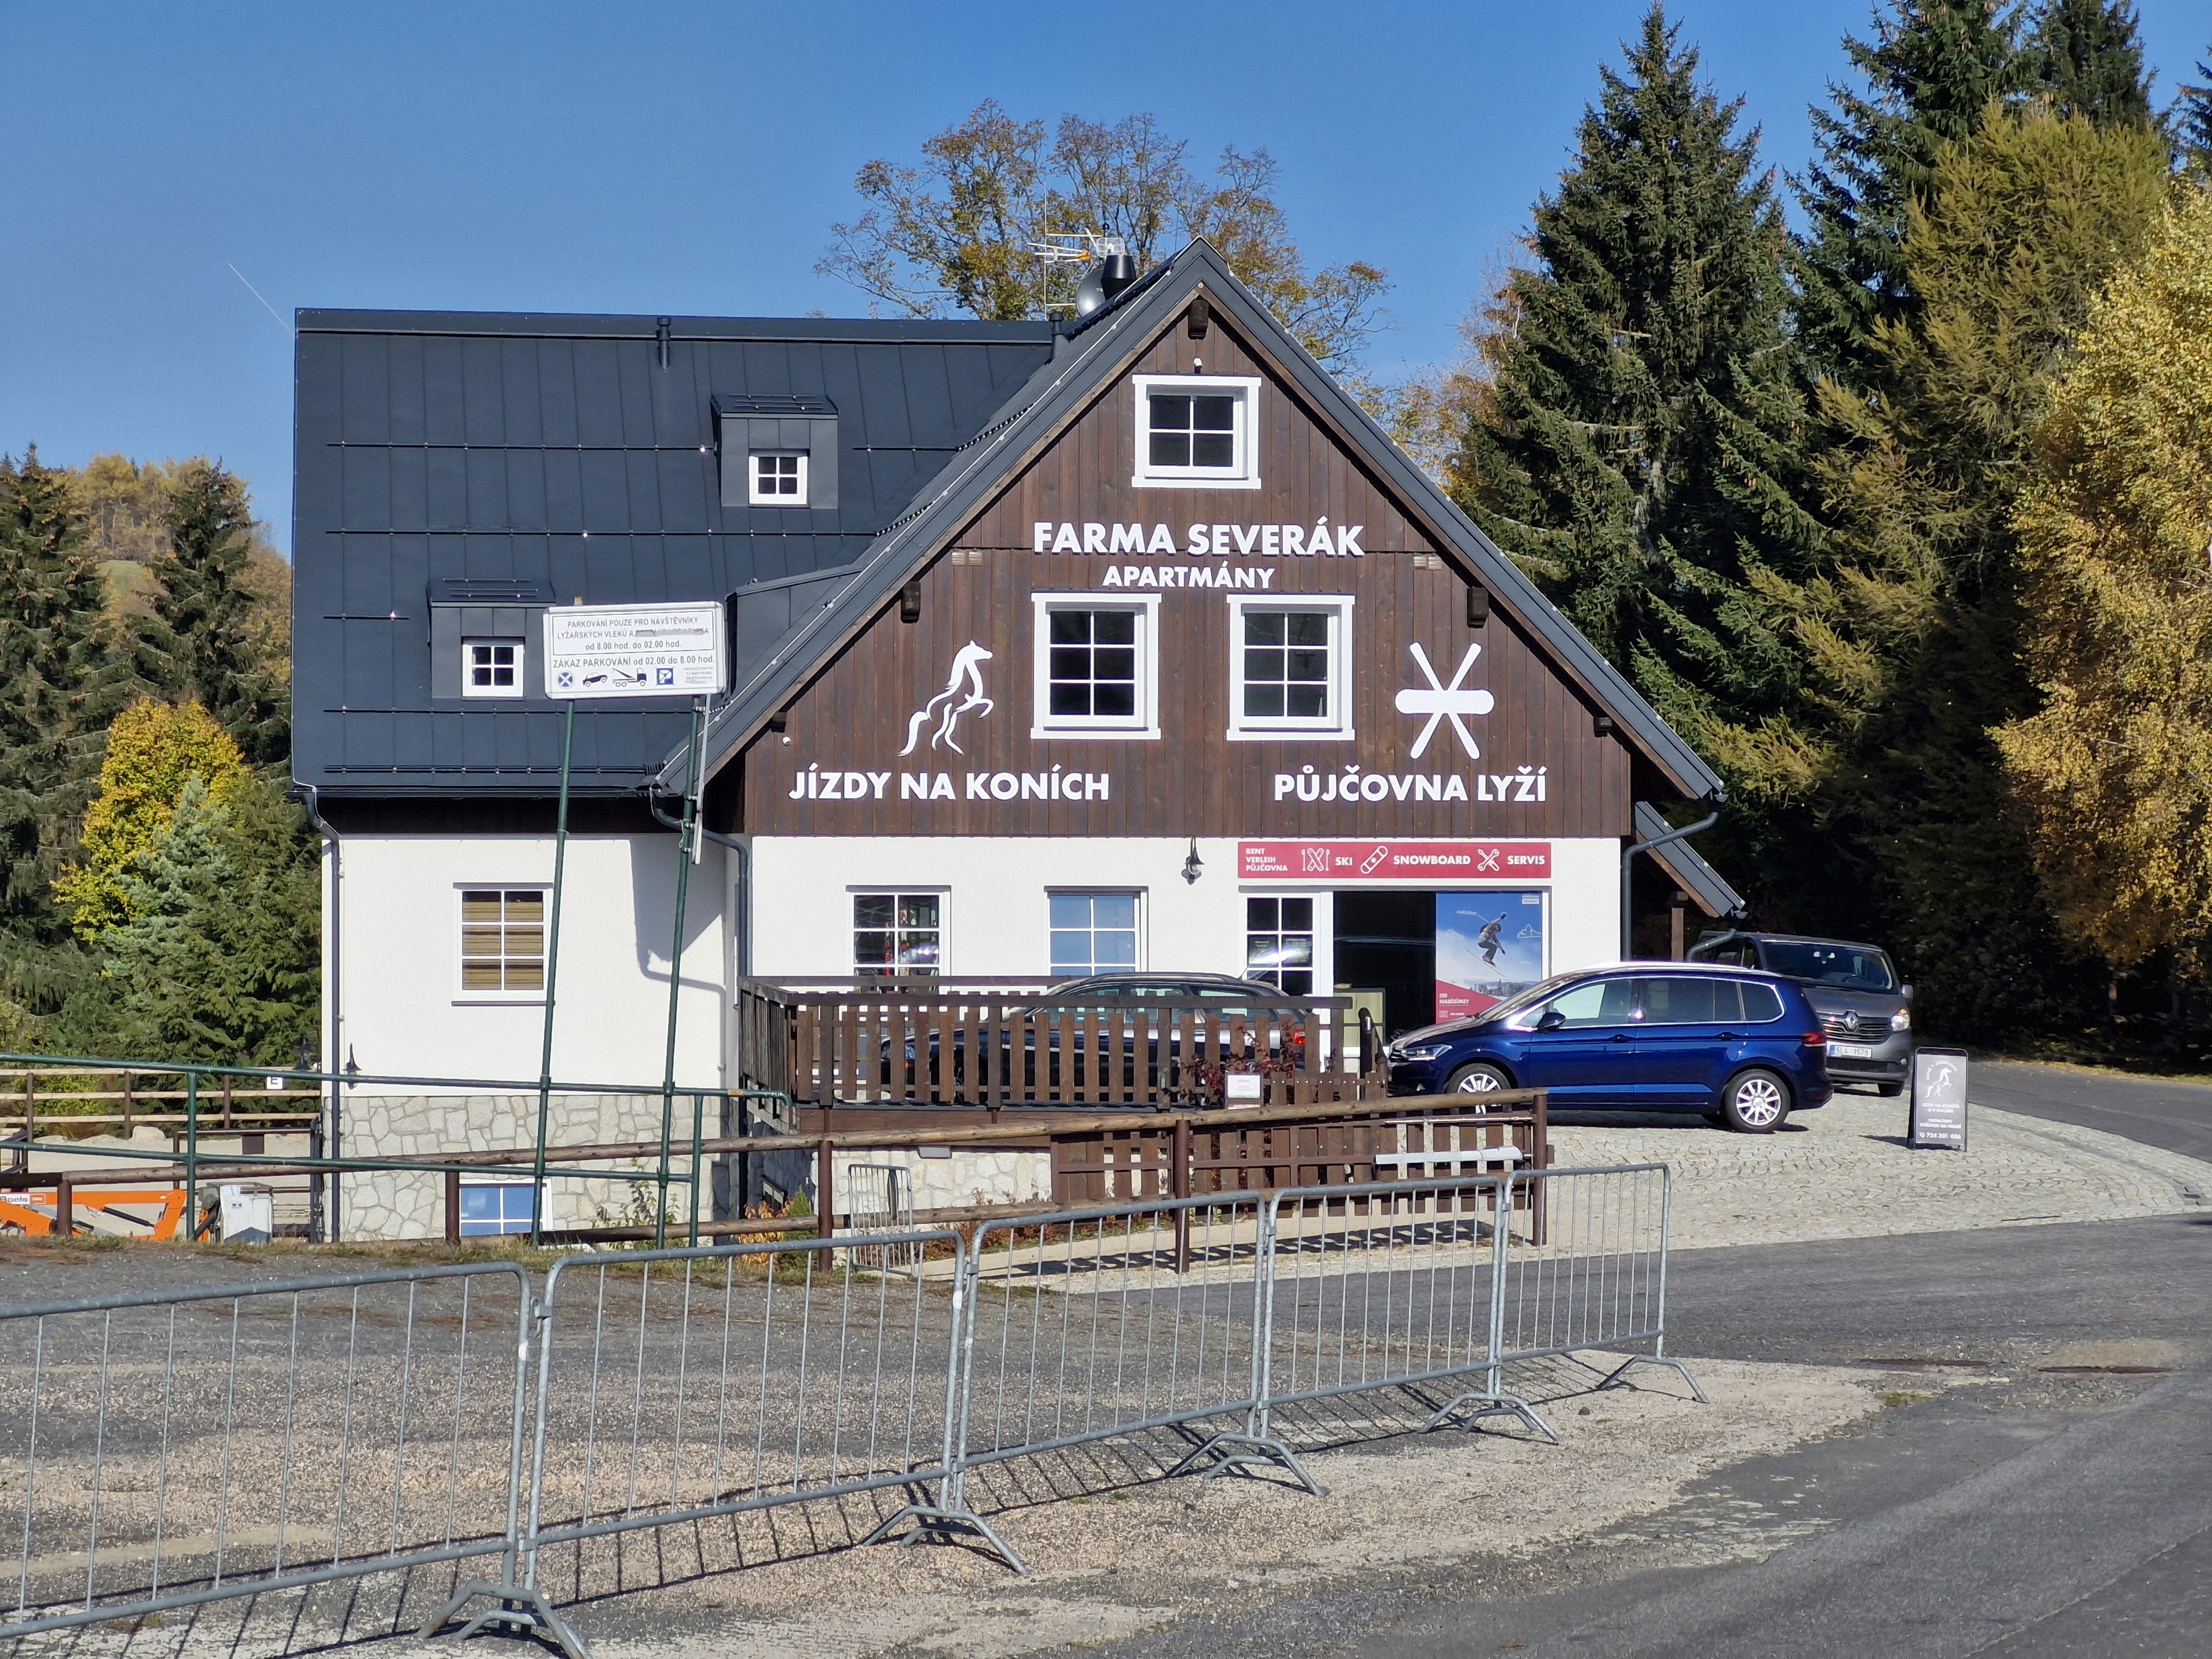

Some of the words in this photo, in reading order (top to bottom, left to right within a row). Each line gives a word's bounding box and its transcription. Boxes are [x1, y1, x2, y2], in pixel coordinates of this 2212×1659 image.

[1034, 522, 1177, 554] FARMA
[1187, 515, 1365, 556] SEVERÁK
[1102, 560, 1275, 588] APARTMÁNY
[567, 618, 608, 628] PARKOVÁNÍ
[651, 616, 698, 625] NÁVŠTĚVNÍKY
[557, 629, 602, 639] LYŽAŘSKÝCH
[604, 629, 627, 637] VLEKŮ
[666, 639, 682, 648] hod.
[554, 658, 581, 667] ZÁKAZ
[583, 655, 630, 667] PARKOVÁNÍ
[645, 656, 665, 665] 02.00
[680, 655, 696, 664] 8.00
[698, 655, 715, 663] hod.
[789, 762, 891, 800] JÍZDY
[900, 772, 956, 800] NA
[966, 763, 1109, 801] KONÍCH
[1274, 765, 1469, 802] PŮJČOVNA
[1477, 765, 1547, 802] LYŽÍ
[1335, 857, 1353, 865] SKI
[1393, 855, 1471, 865] SNOWBOARD
[1507, 855, 1546, 865] SERVIS
